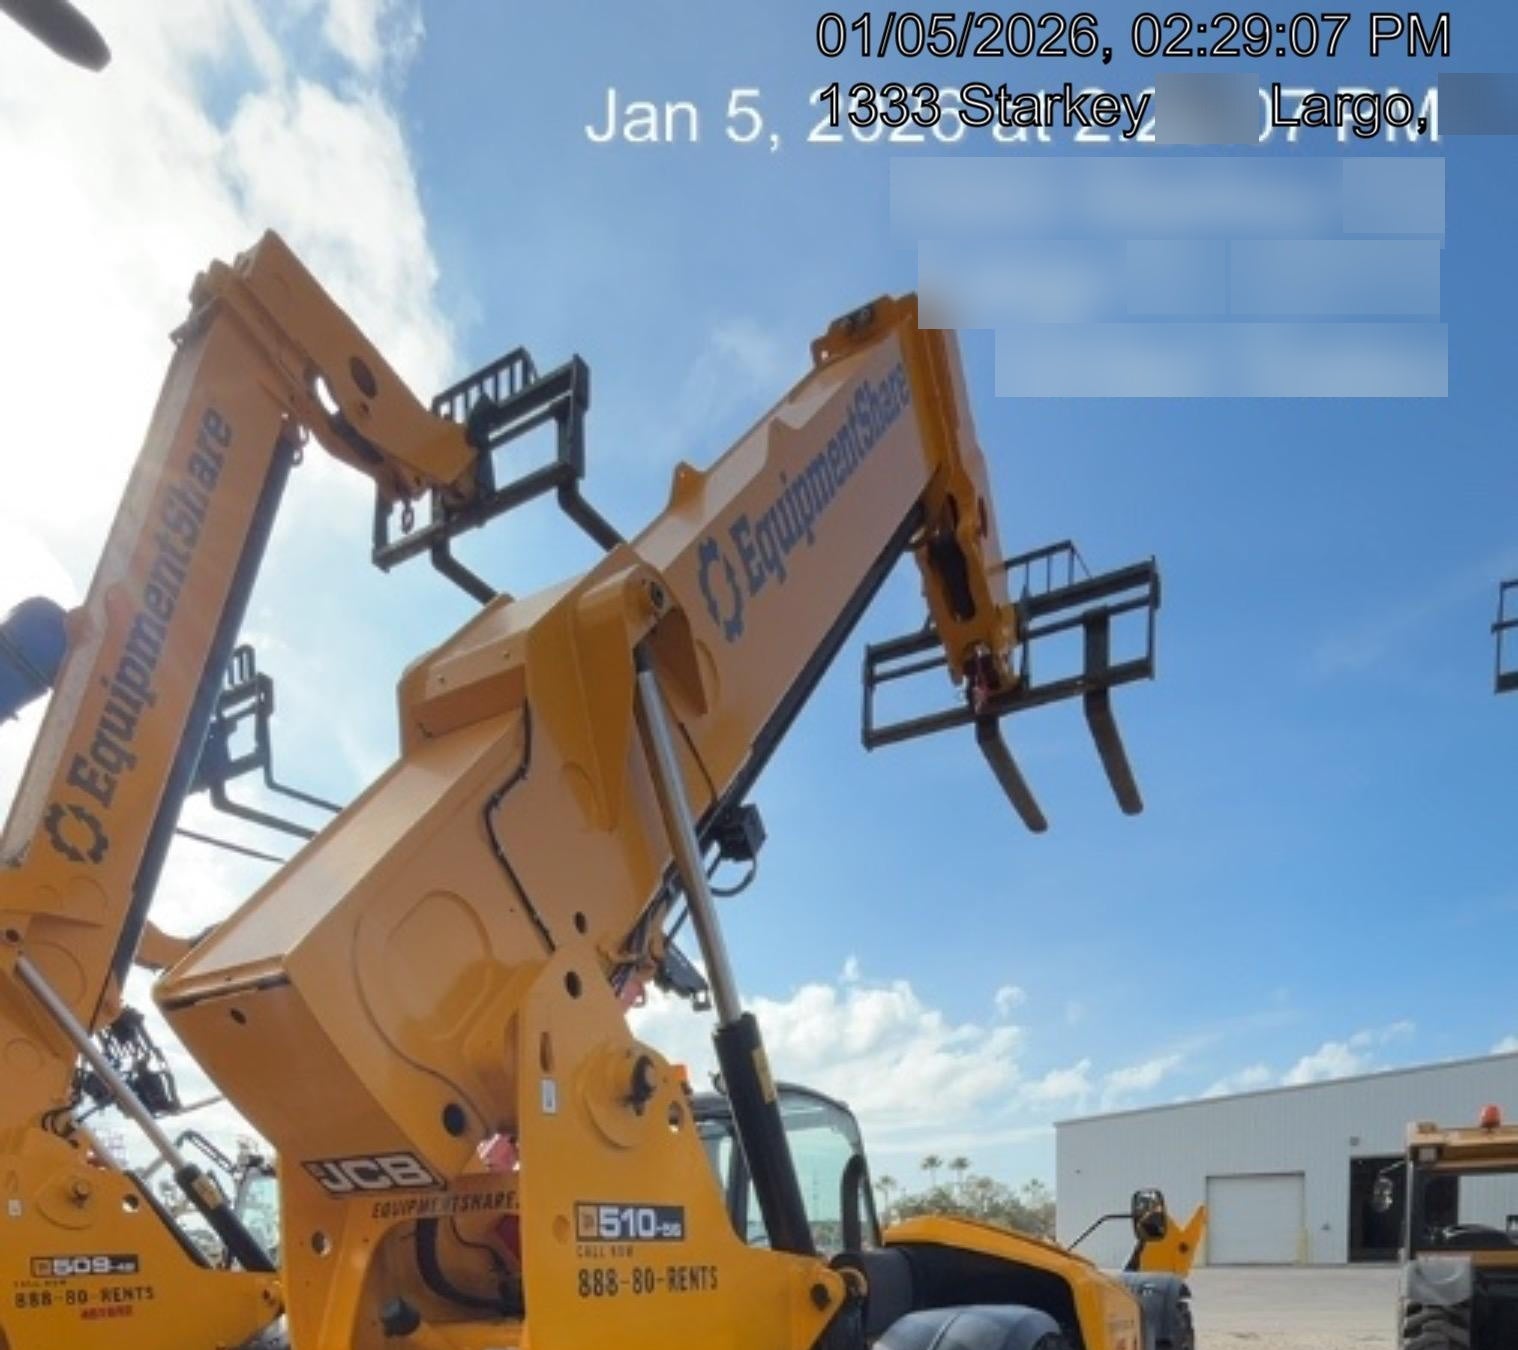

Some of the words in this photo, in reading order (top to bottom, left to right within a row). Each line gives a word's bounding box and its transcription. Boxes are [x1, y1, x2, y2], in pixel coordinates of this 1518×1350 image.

[729, 361, 912, 598] EquipmentShare
[66, 405, 234, 810] EquipmentShare
[318, 1152, 436, 1194] JCB
[577, 1264, 718, 1299] 888-80-RENTS
